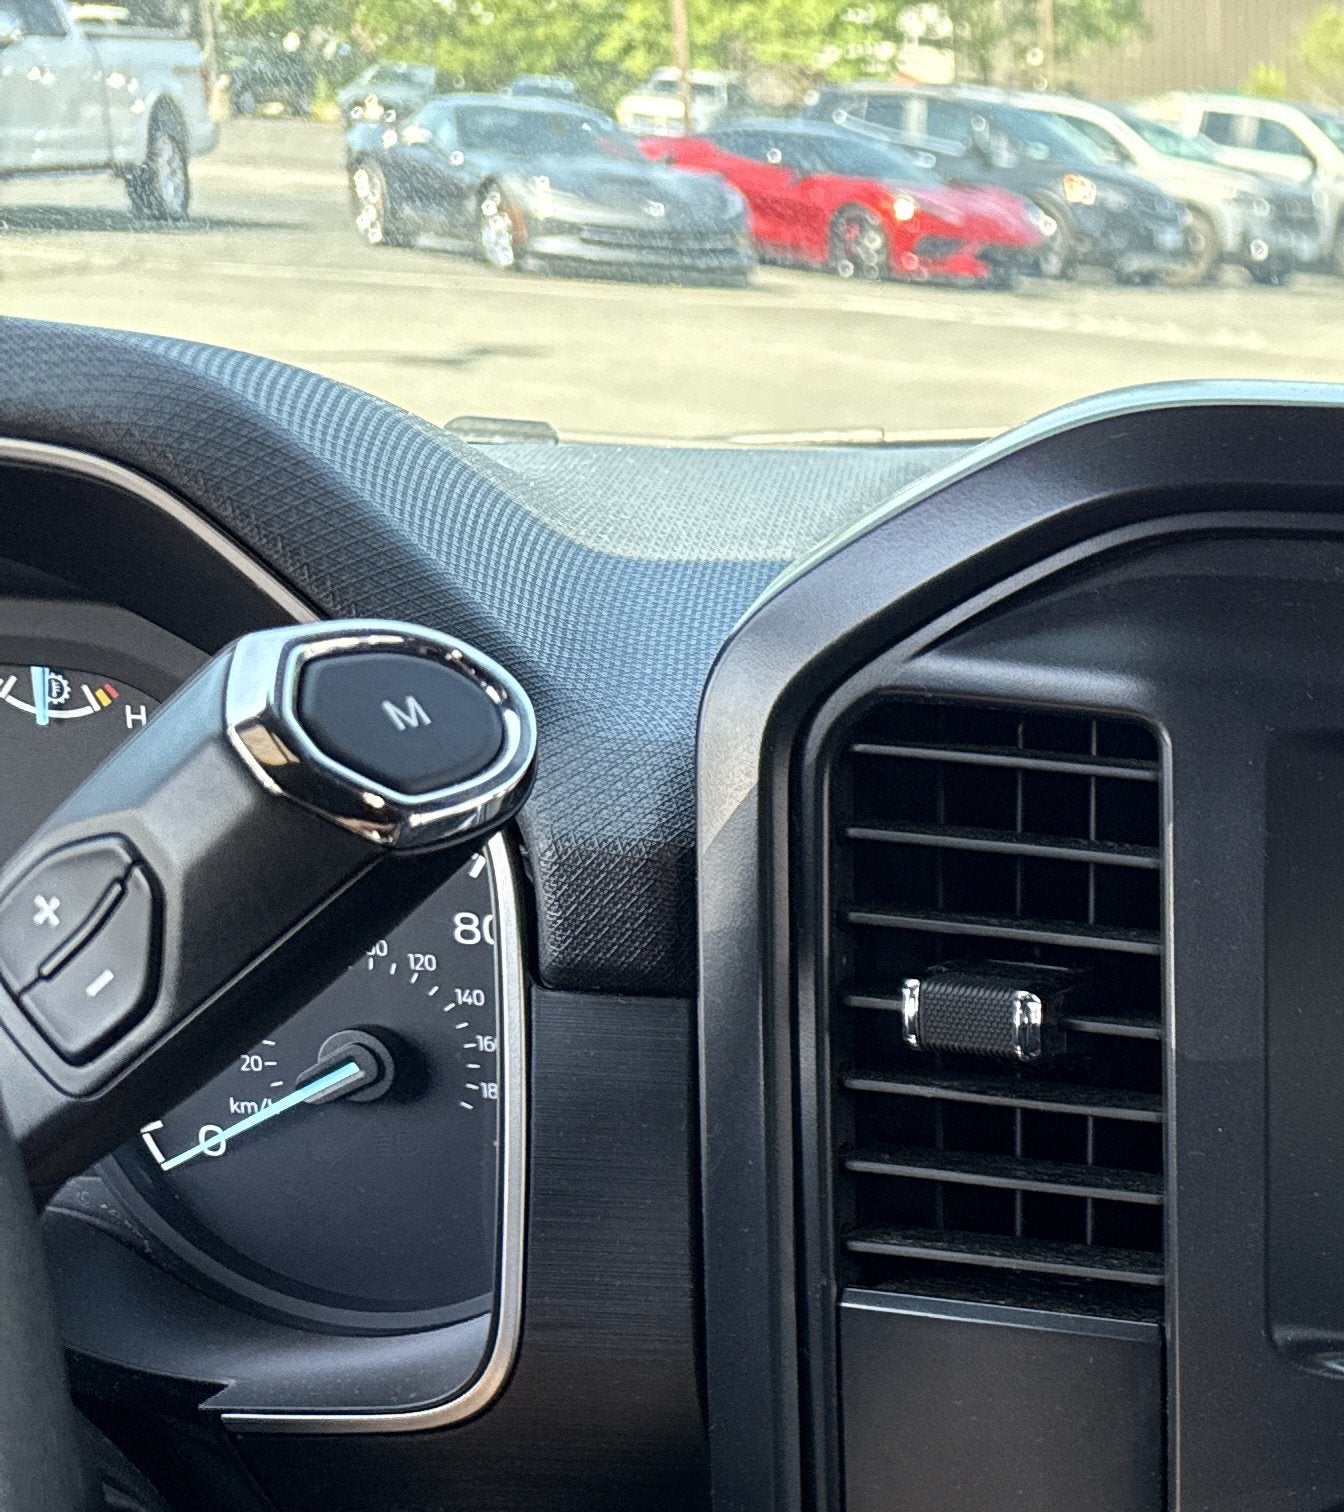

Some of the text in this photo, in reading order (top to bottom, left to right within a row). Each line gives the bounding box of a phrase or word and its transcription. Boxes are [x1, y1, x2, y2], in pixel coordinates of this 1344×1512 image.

[125, 704, 147, 728] H
[381, 695, 433, 732] M
[408, 953, 437, 972] 120
[454, 988, 485, 1007] 140
[477, 1035, 496, 1053] 16
[240, 1054, 263, 1072] 20
[480, 1082, 498, 1100] 18
